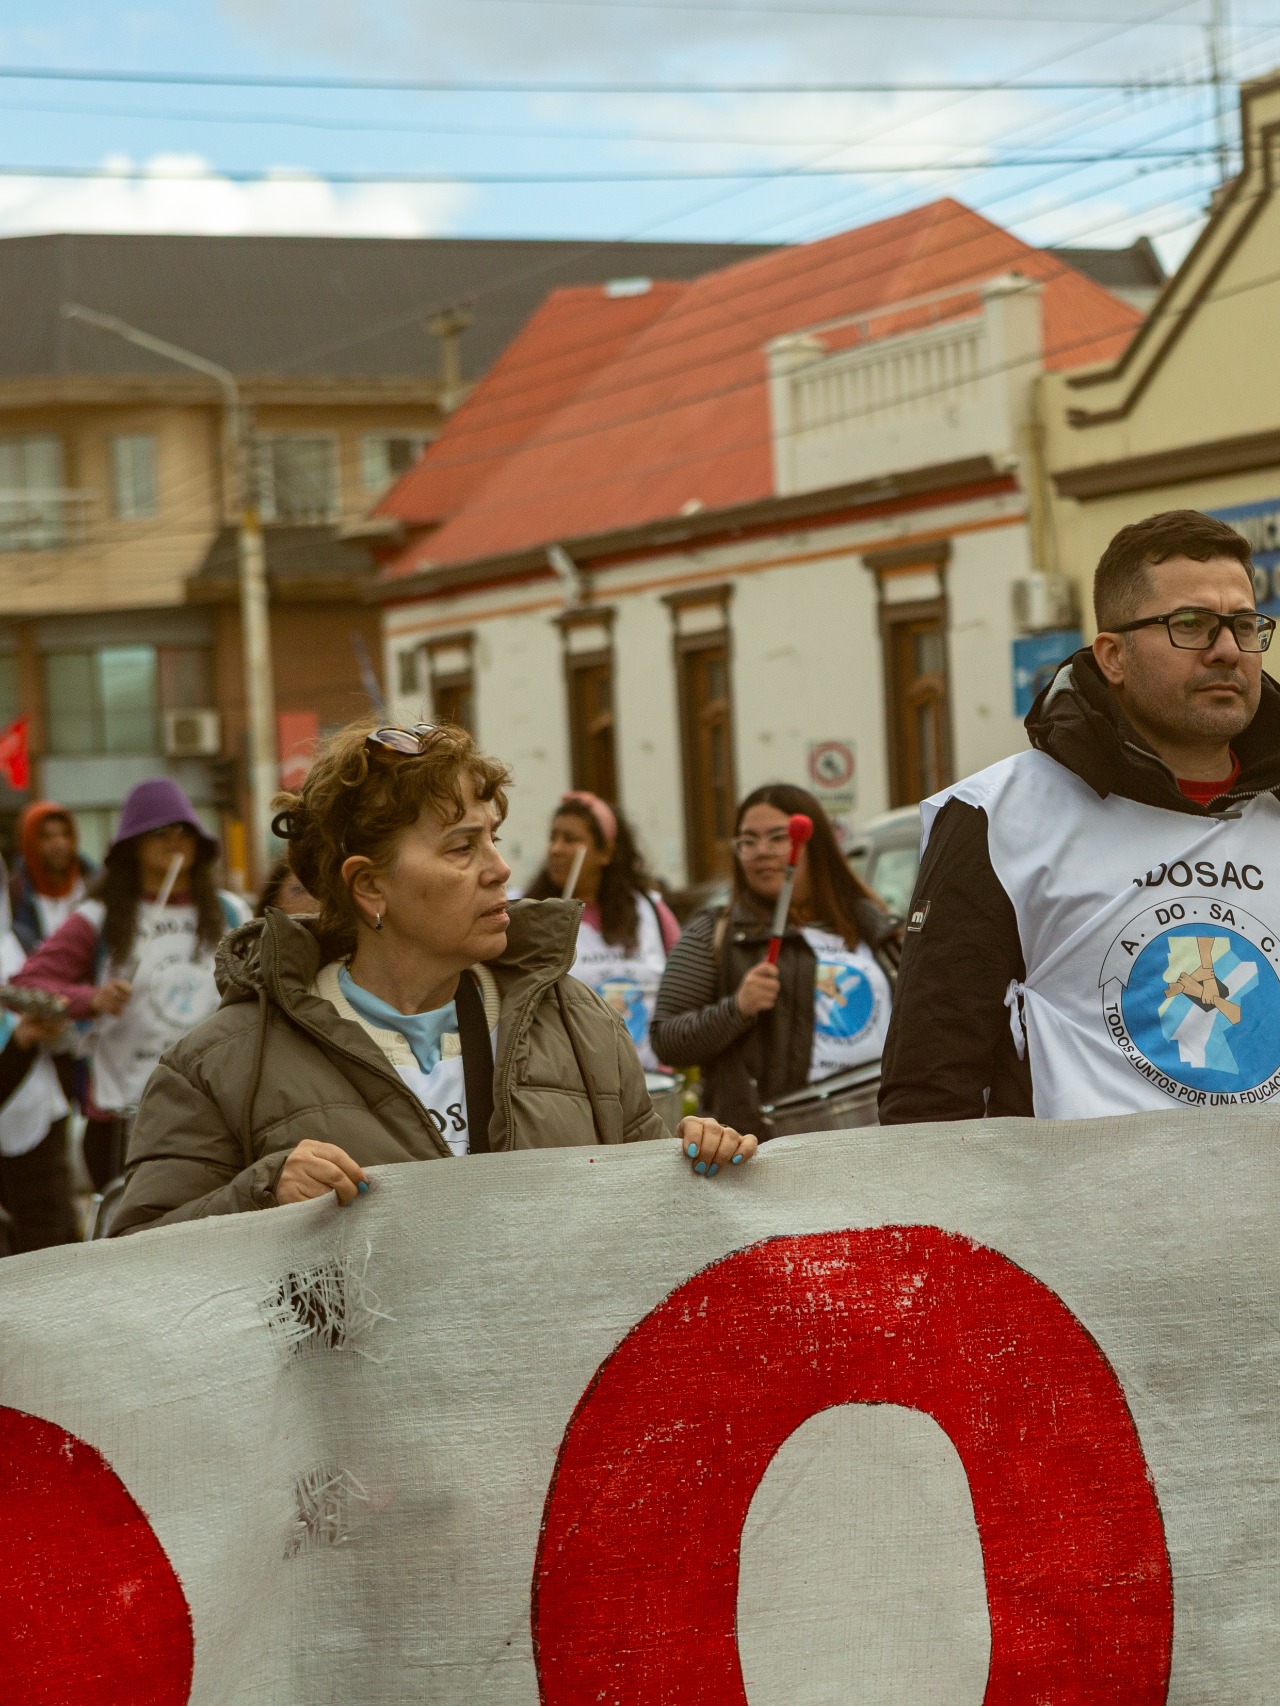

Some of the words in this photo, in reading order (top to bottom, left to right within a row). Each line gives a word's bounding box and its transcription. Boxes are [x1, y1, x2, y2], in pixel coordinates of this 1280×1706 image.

[1105, 1002, 1135, 1053] TODOS
[1130, 1053, 1178, 1095] JUNTOS
[1178, 1085, 1206, 1106] POR
[1209, 1093, 1237, 1107] UNA
